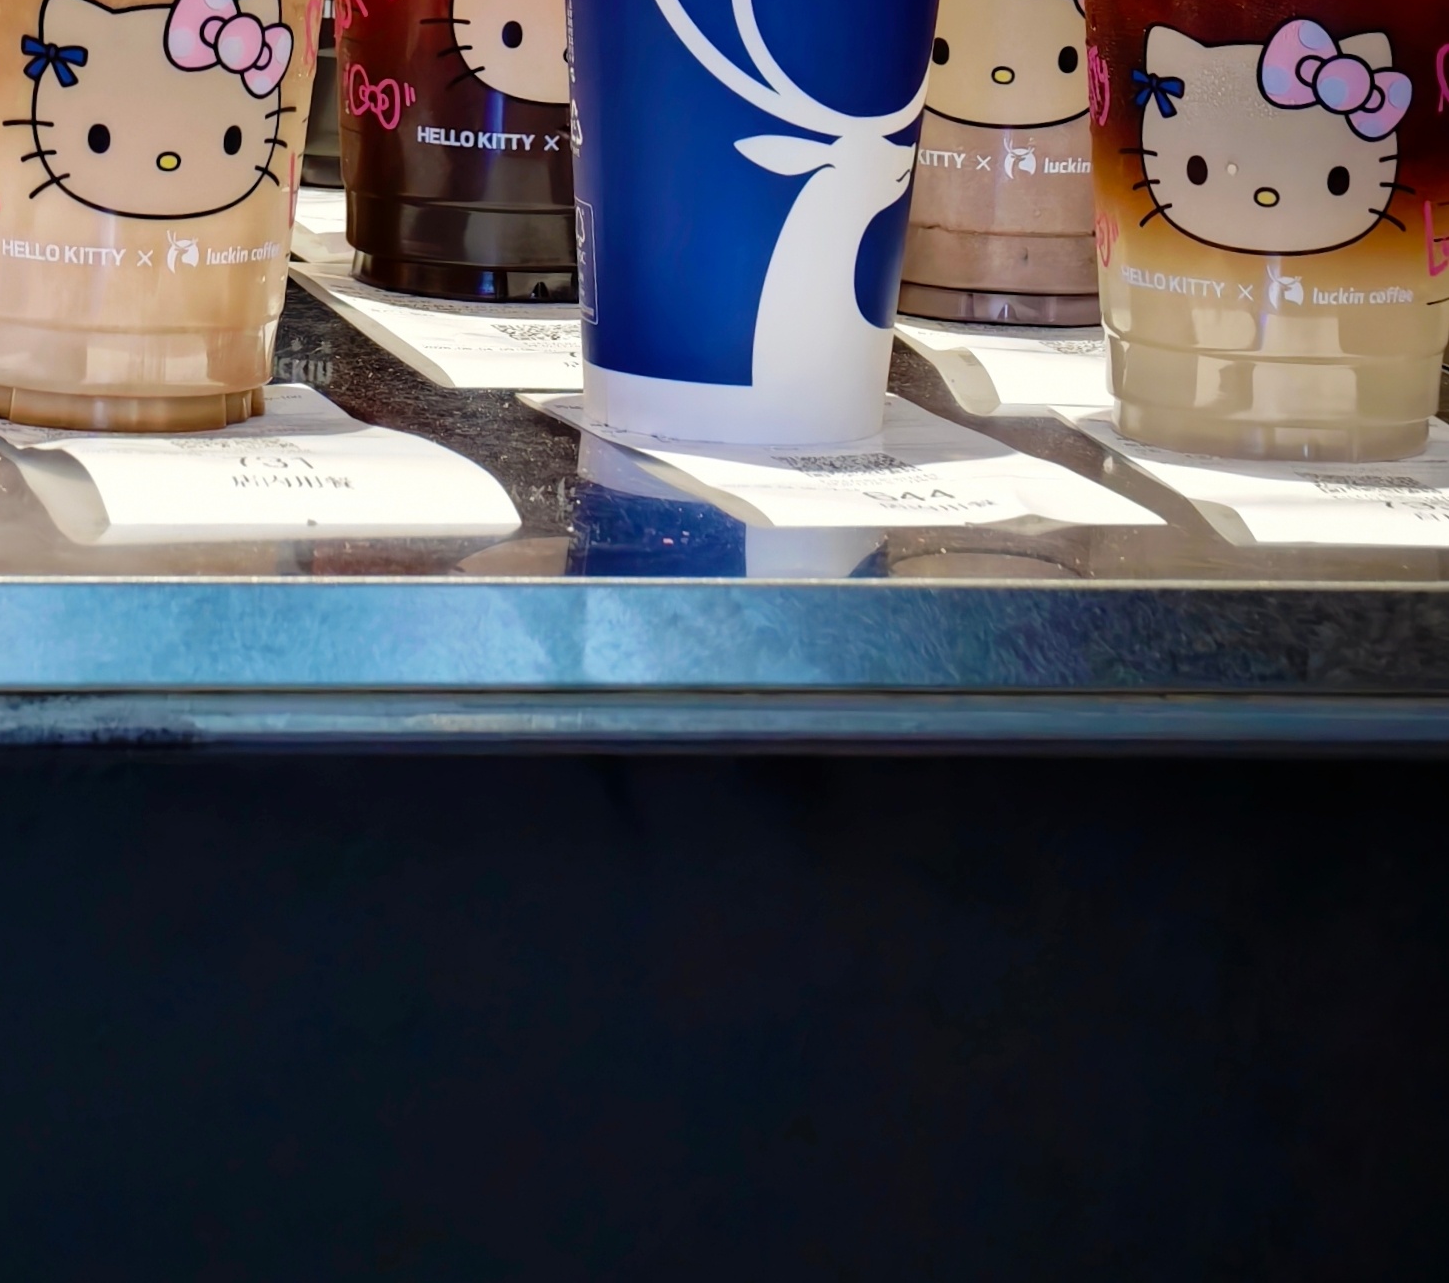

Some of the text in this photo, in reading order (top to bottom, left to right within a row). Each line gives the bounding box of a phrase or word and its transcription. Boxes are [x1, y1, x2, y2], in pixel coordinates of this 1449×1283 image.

[417, 125, 475, 149] HELLO
[477, 132, 535, 152] KITTY
[1043, 157, 1093, 174] luckin
[1, 238, 61, 263] HELLO
[64, 245, 128, 268] KITTY
[205, 247, 249, 267] luckin
[1120, 266, 1166, 291] HELLO
[1169, 275, 1226, 299] KITTY
[1312, 286, 1365, 305] luckin
